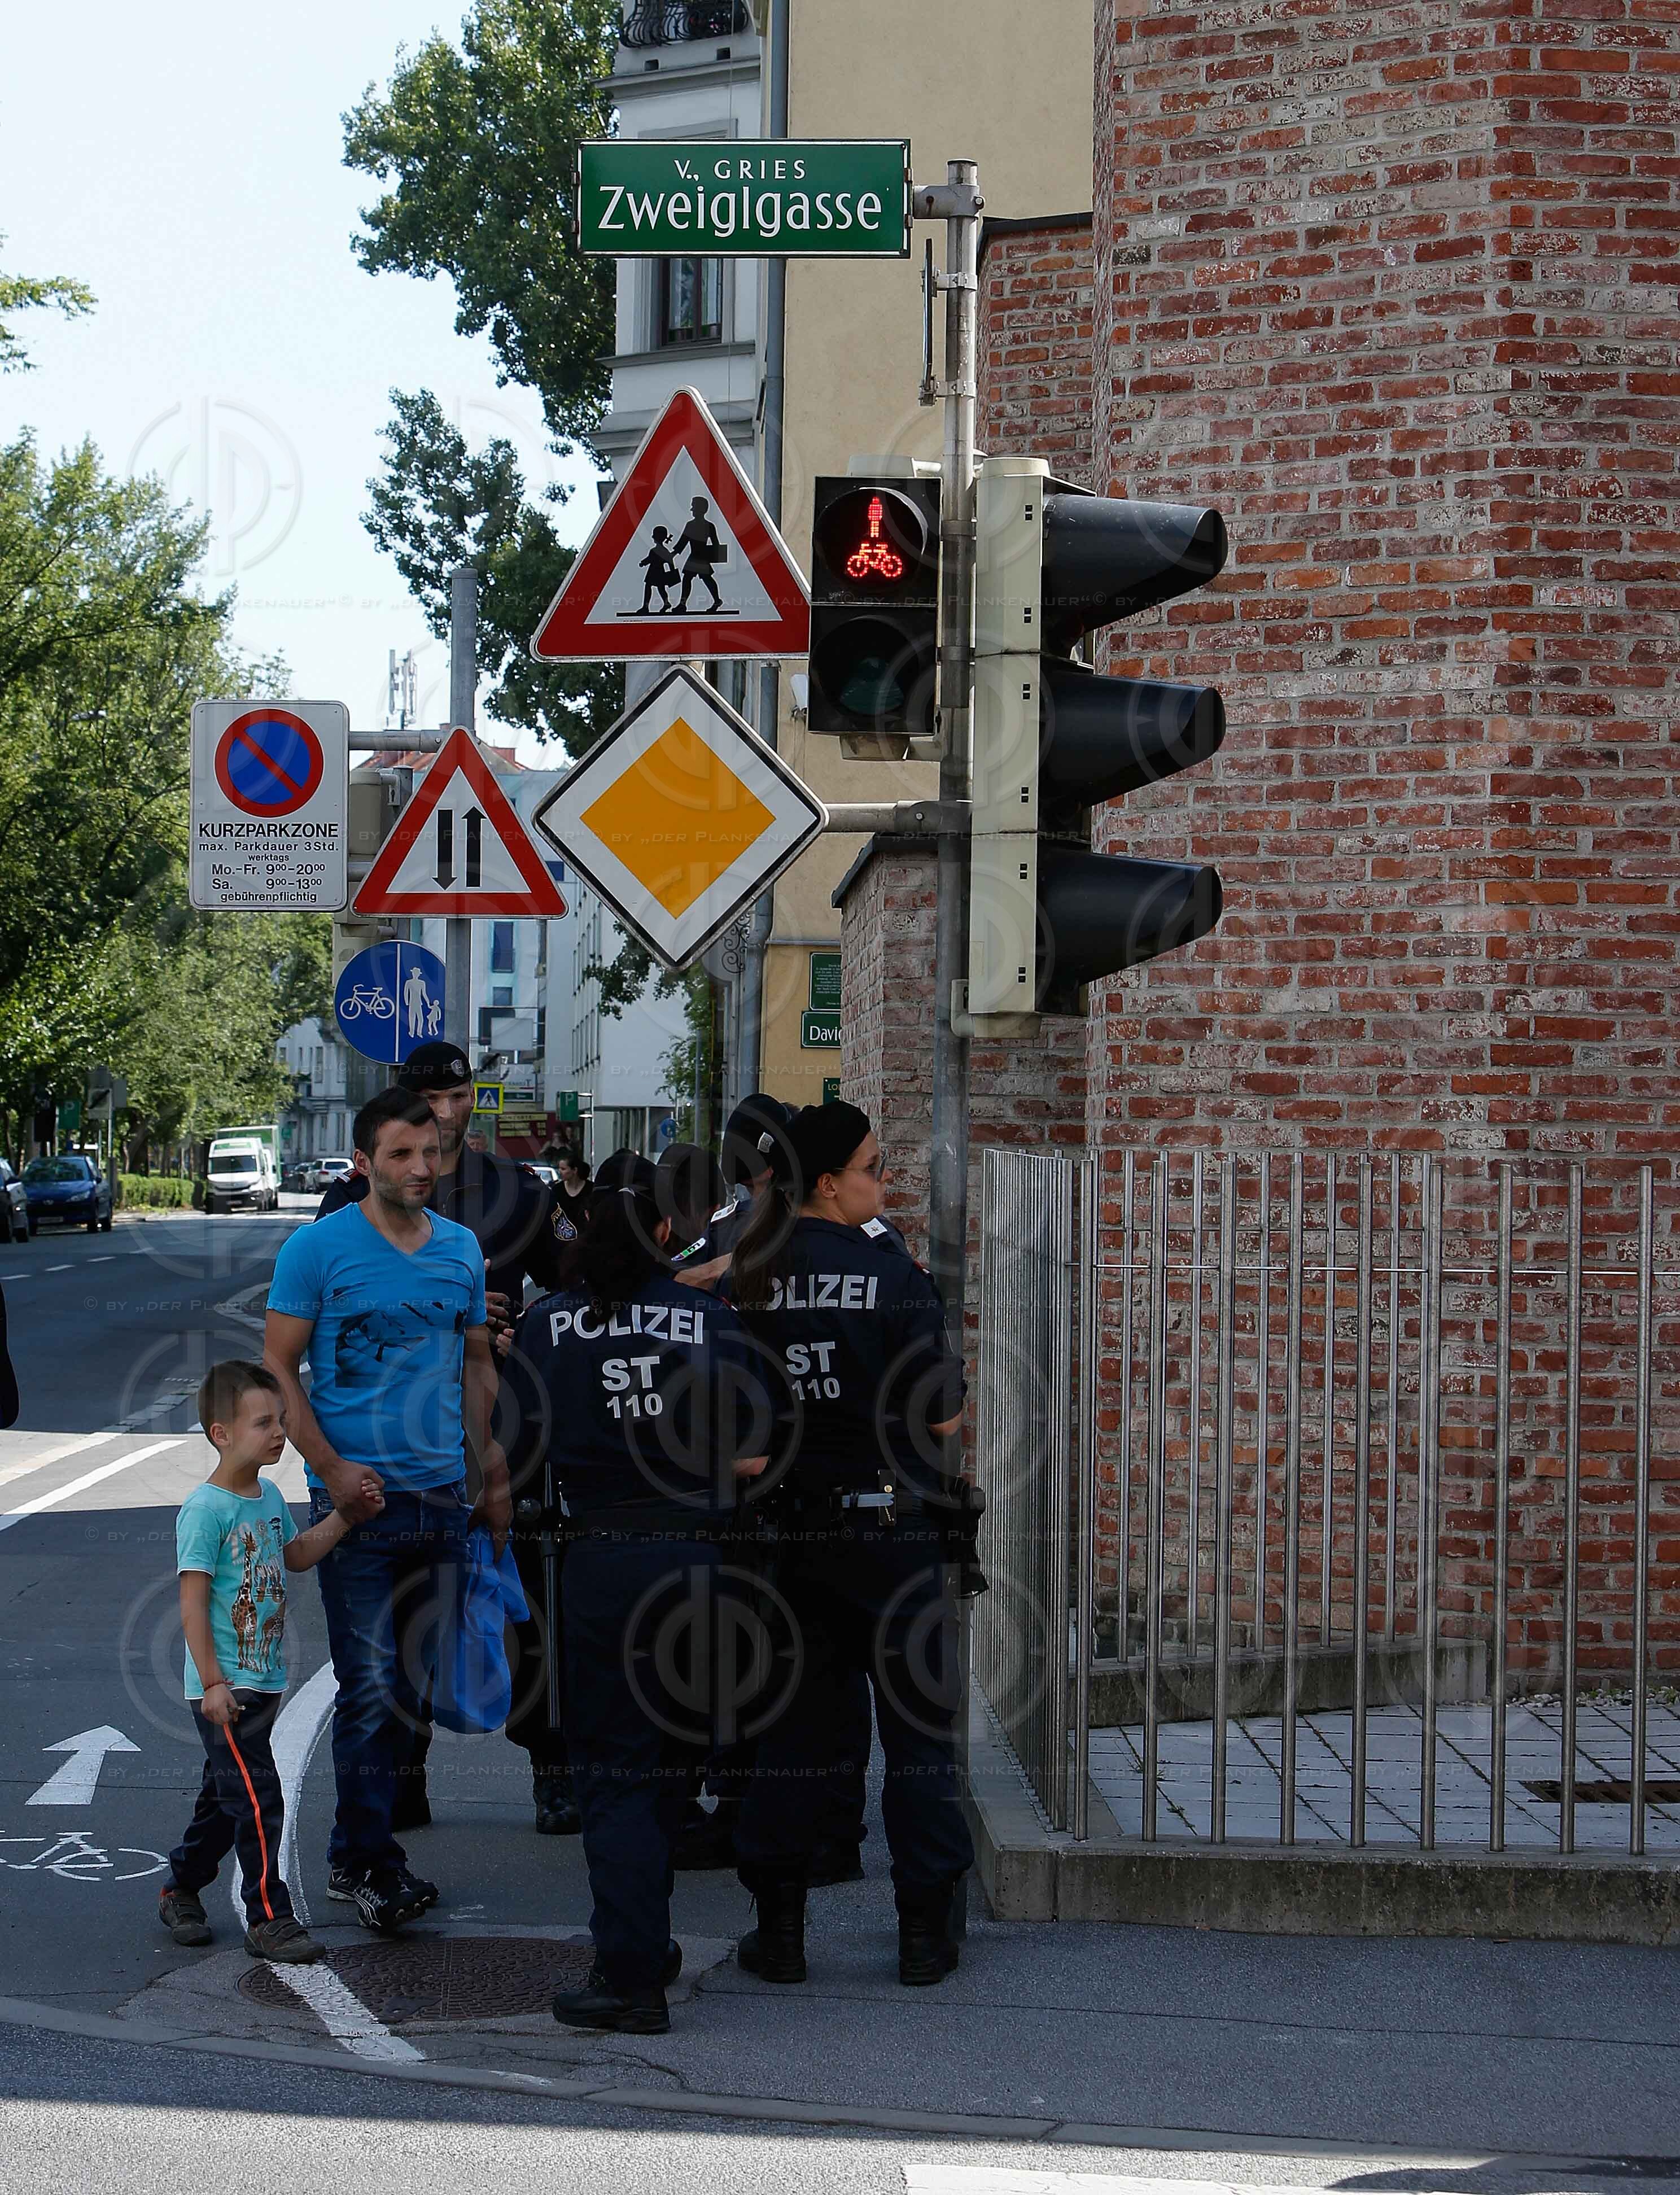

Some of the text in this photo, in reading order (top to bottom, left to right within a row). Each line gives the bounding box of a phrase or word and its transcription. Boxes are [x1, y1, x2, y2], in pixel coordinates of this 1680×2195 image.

[714, 159, 806, 180] GRIES
[598, 186, 882, 238] Zweiglgasse
[199, 823, 338, 837] KURZPARKZONE
[234, 842, 298, 851] Parkdauer
[248, 854, 289, 863] werktags
[212, 878, 233, 890] Sa.
[221, 891, 317, 903] gebührenpflichtig
[549, 1304, 704, 1346] POLIZEI
[786, 1341, 836, 1375] ST
[601, 1356, 660, 1392] ST
[791, 1377, 841, 1400] 110
[607, 1393, 663, 1418] 110
